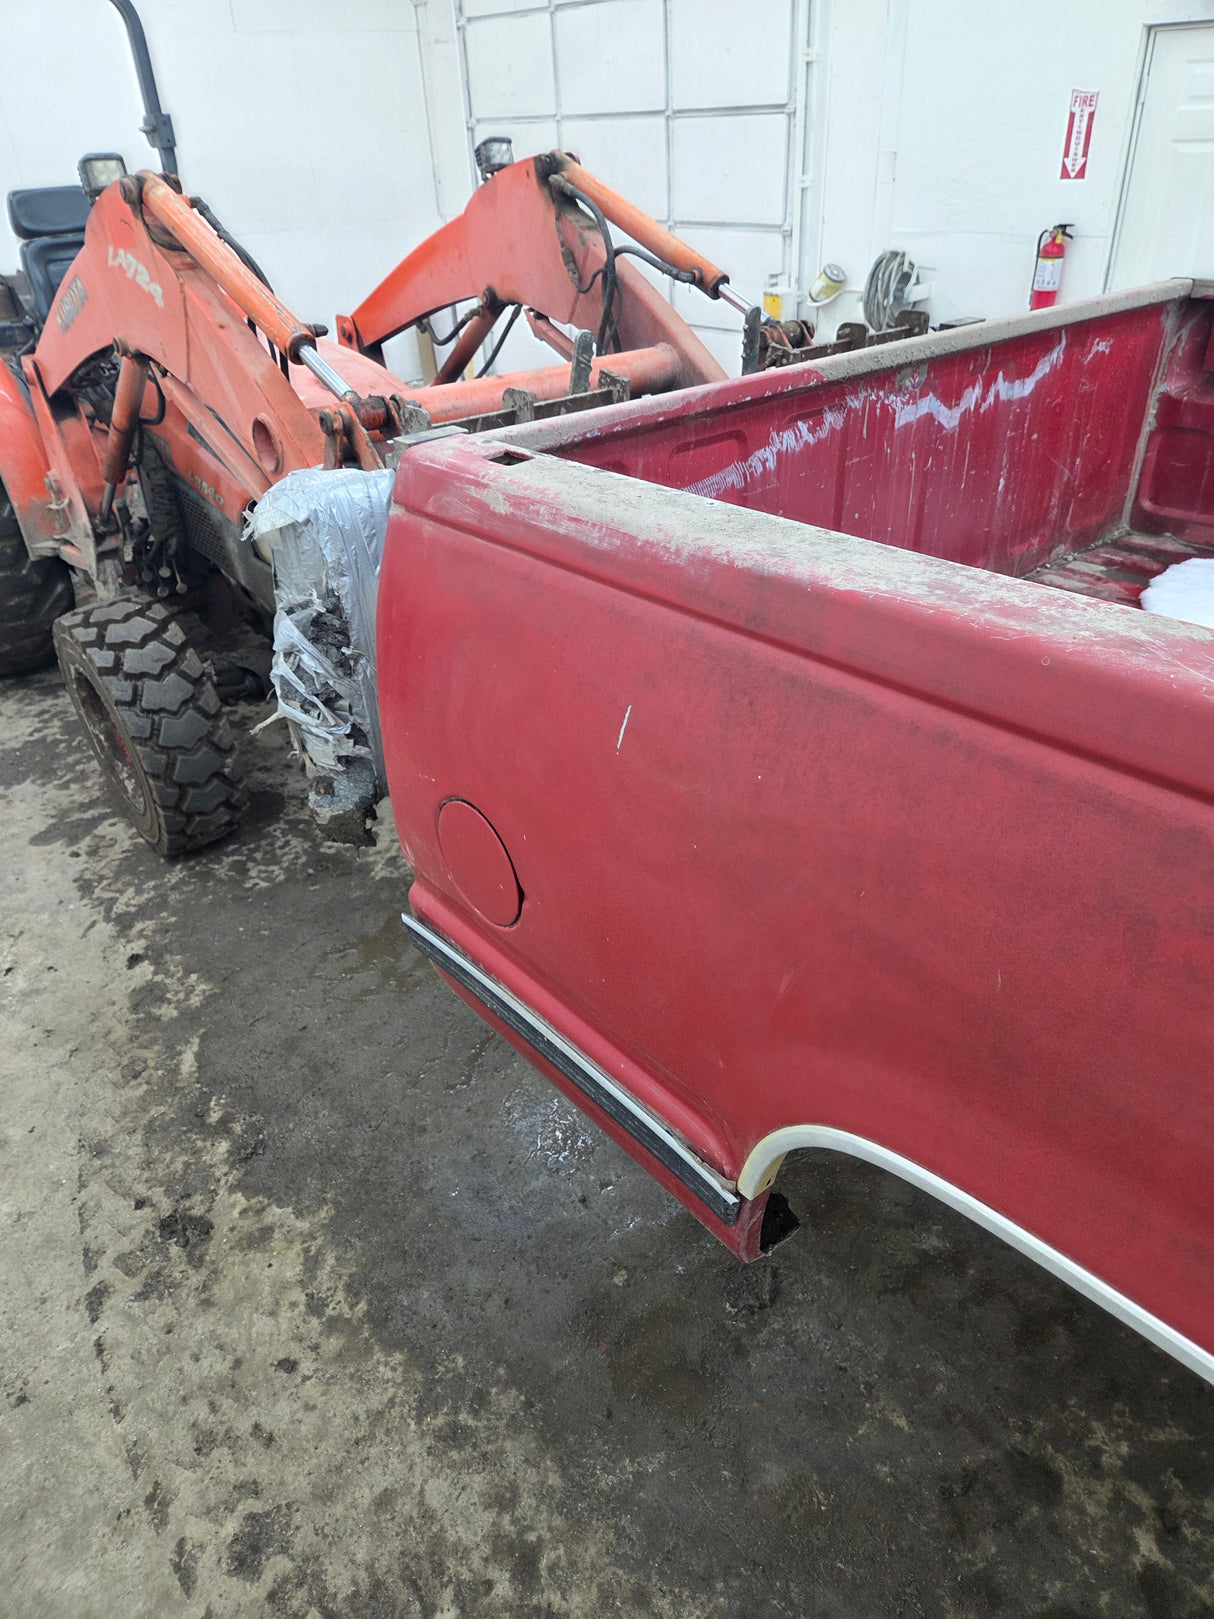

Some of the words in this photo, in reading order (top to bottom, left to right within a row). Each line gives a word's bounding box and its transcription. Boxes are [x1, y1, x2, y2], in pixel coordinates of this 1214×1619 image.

[1073, 94, 1095, 107] FIRE
[1071, 107, 1085, 172] EXTINGUISHER
[107, 245, 164, 308] LA724
